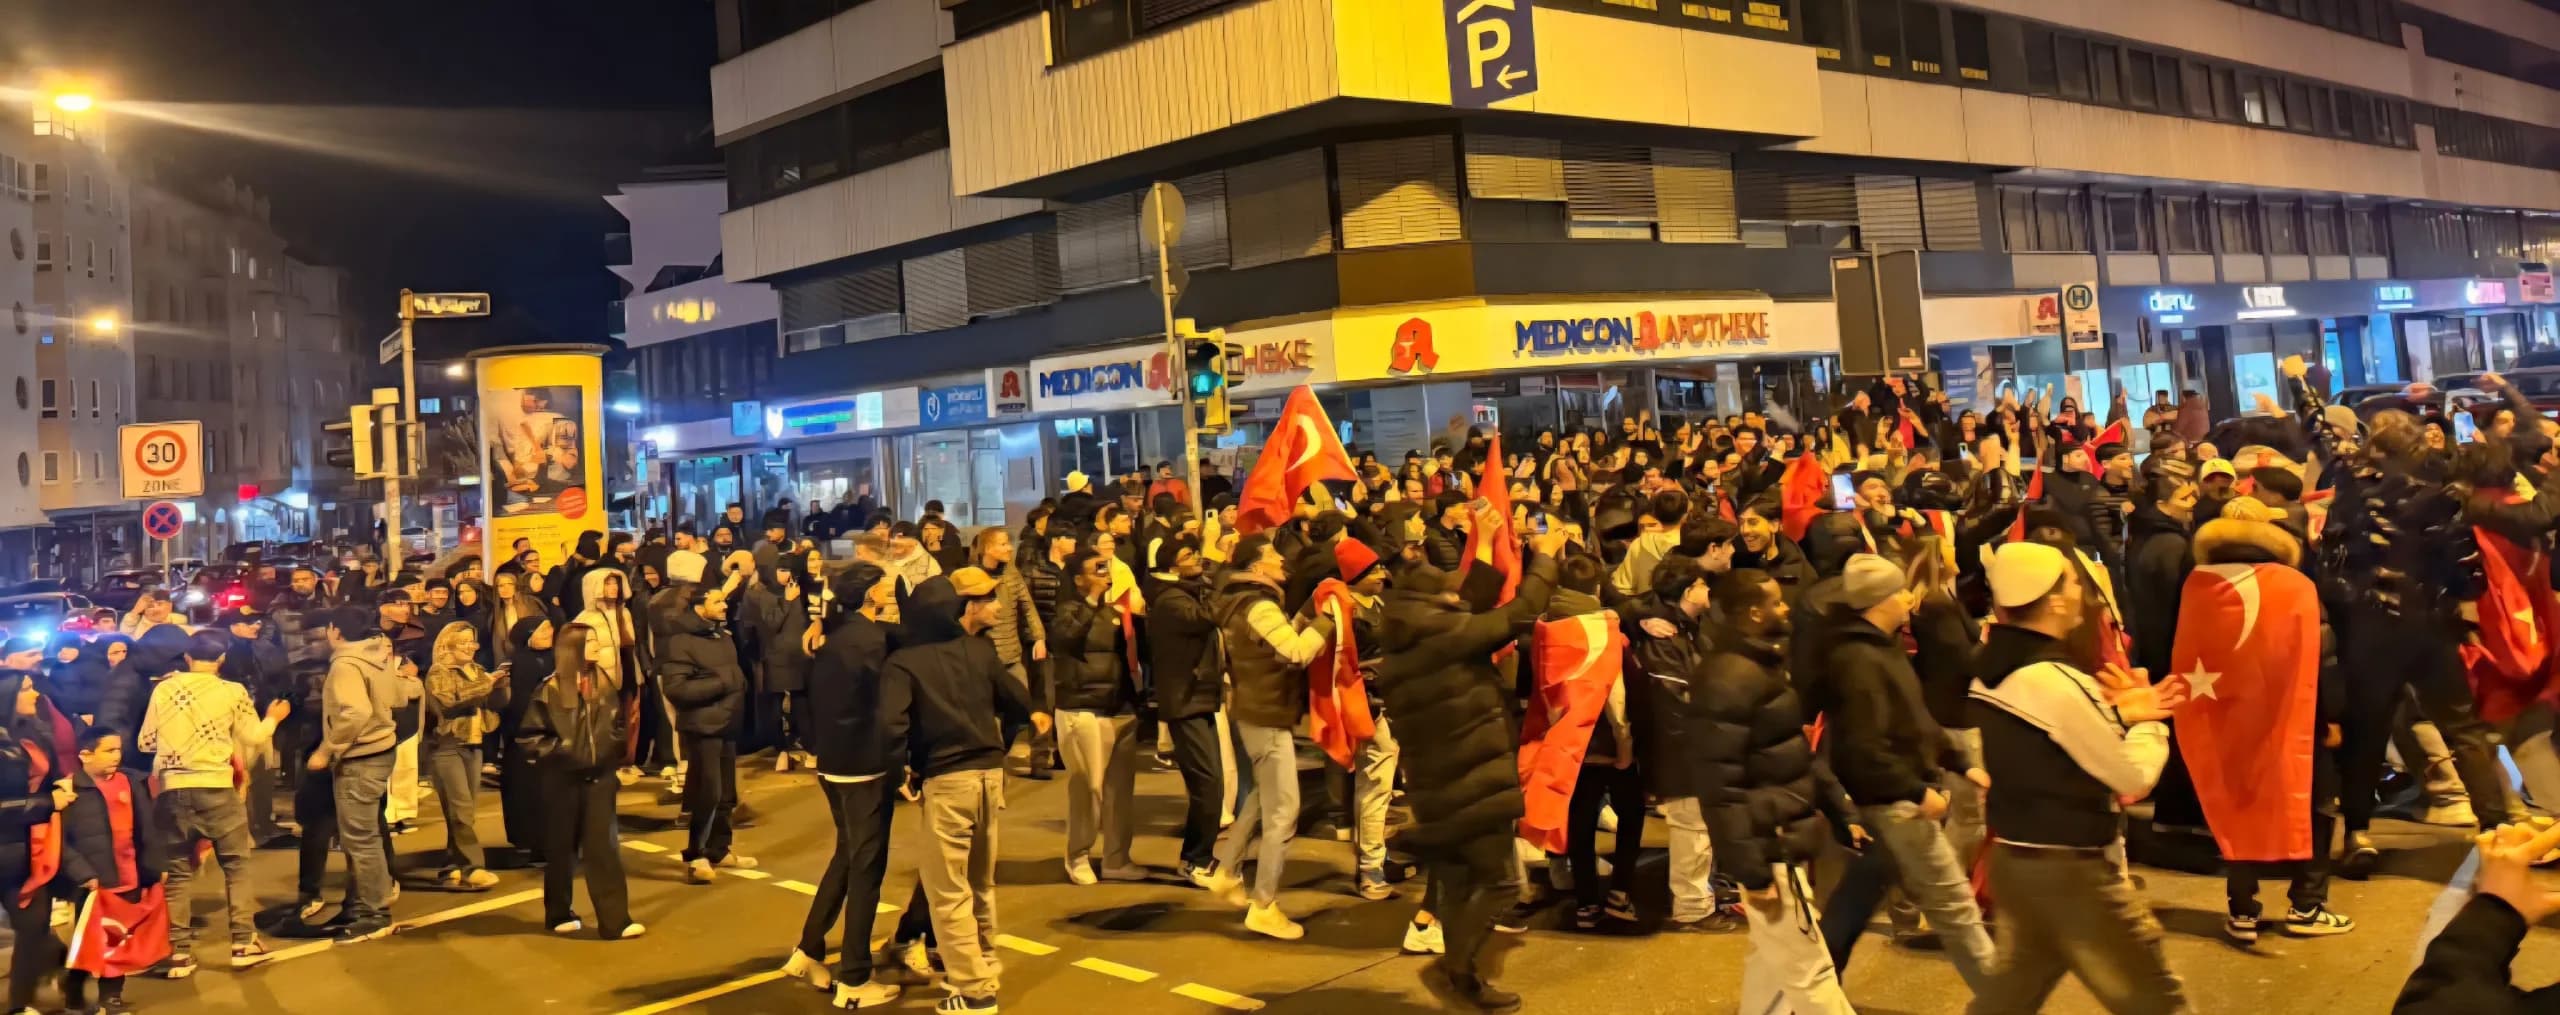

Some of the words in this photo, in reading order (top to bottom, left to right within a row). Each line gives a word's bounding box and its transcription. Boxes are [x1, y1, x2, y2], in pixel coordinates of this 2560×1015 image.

[1467, 18, 1511, 89] P
[1515, 316, 1633, 352] MEDICON
[1660, 311, 1771, 346] APOTHEKE
[1039, 359, 1143, 399] MEDICON
[1243, 338, 1313, 375] HEKE
[147, 442, 176, 464] 30
[142, 478, 183, 493] ZONE
